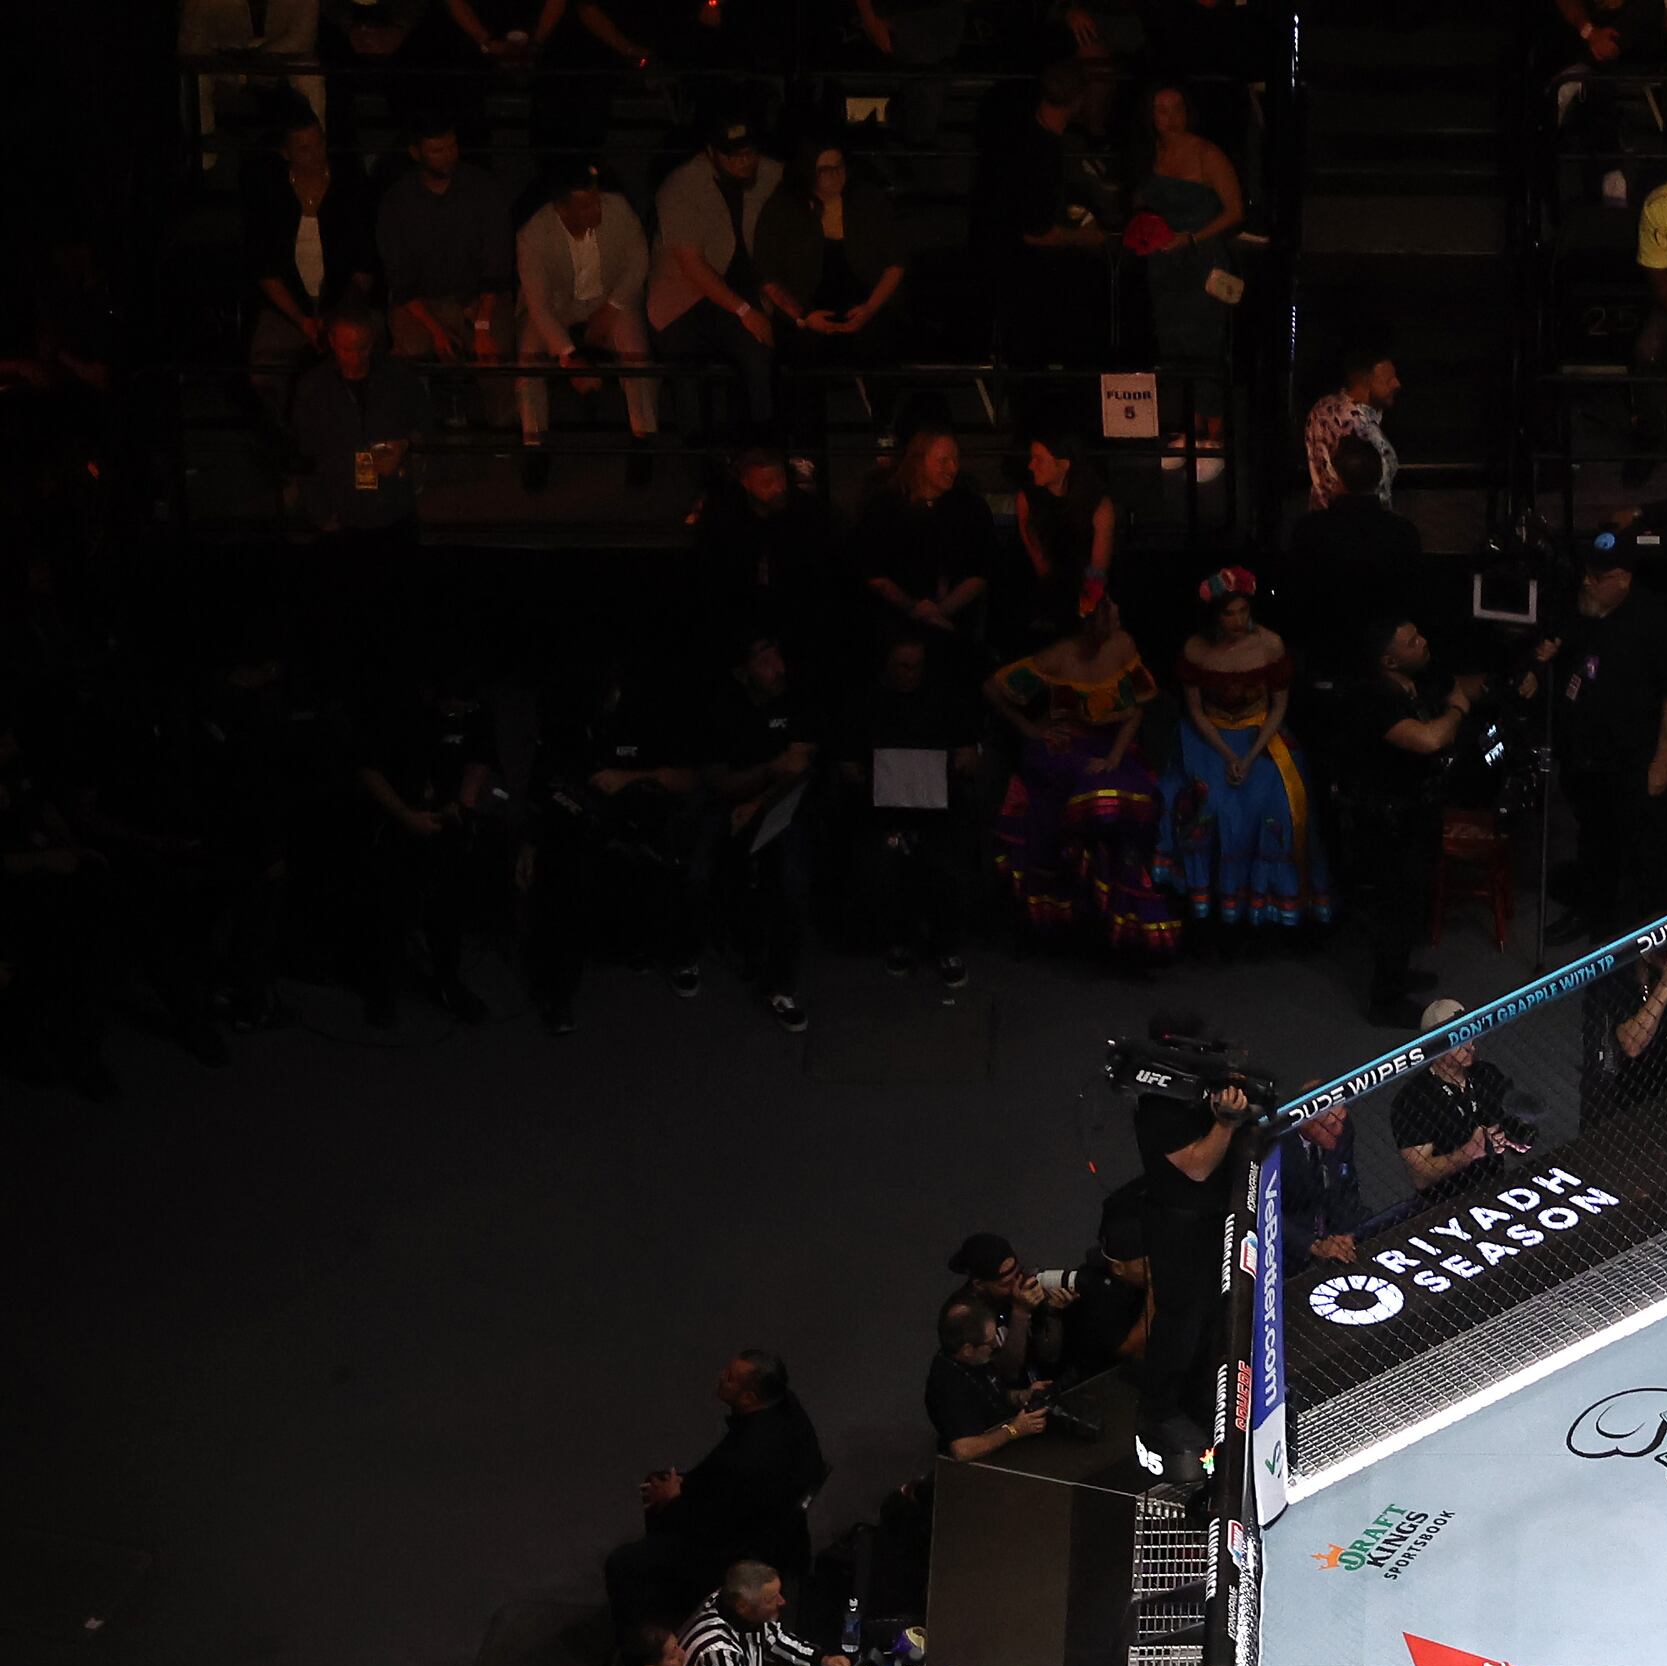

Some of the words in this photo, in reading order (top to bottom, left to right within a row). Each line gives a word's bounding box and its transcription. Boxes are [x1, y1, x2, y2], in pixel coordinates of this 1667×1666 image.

[1107, 391, 1152, 401] FLOOR
[1125, 406, 1136, 420] 5
[1448, 1010, 1494, 1047] DON'T
[1497, 983, 1560, 1023] GRAPPLE
[1559, 964, 1598, 998] WITH
[1598, 954, 1616, 978] TP
[1135, 1069, 1172, 1088] UFC
[1288, 1087, 1346, 1128] DUDE
[1347, 1048, 1425, 1098] WIPES
[1372, 1167, 1582, 1274] RIYADH
[1413, 1187, 1620, 1293] SEASON
[1259, 1170, 1279, 1408] VeBetter.com
[1338, 1503, 1408, 1571] DRAFT
[1366, 1511, 1429, 1568] KINGS
[1384, 1510, 1455, 1580] SPORTSBOOK
